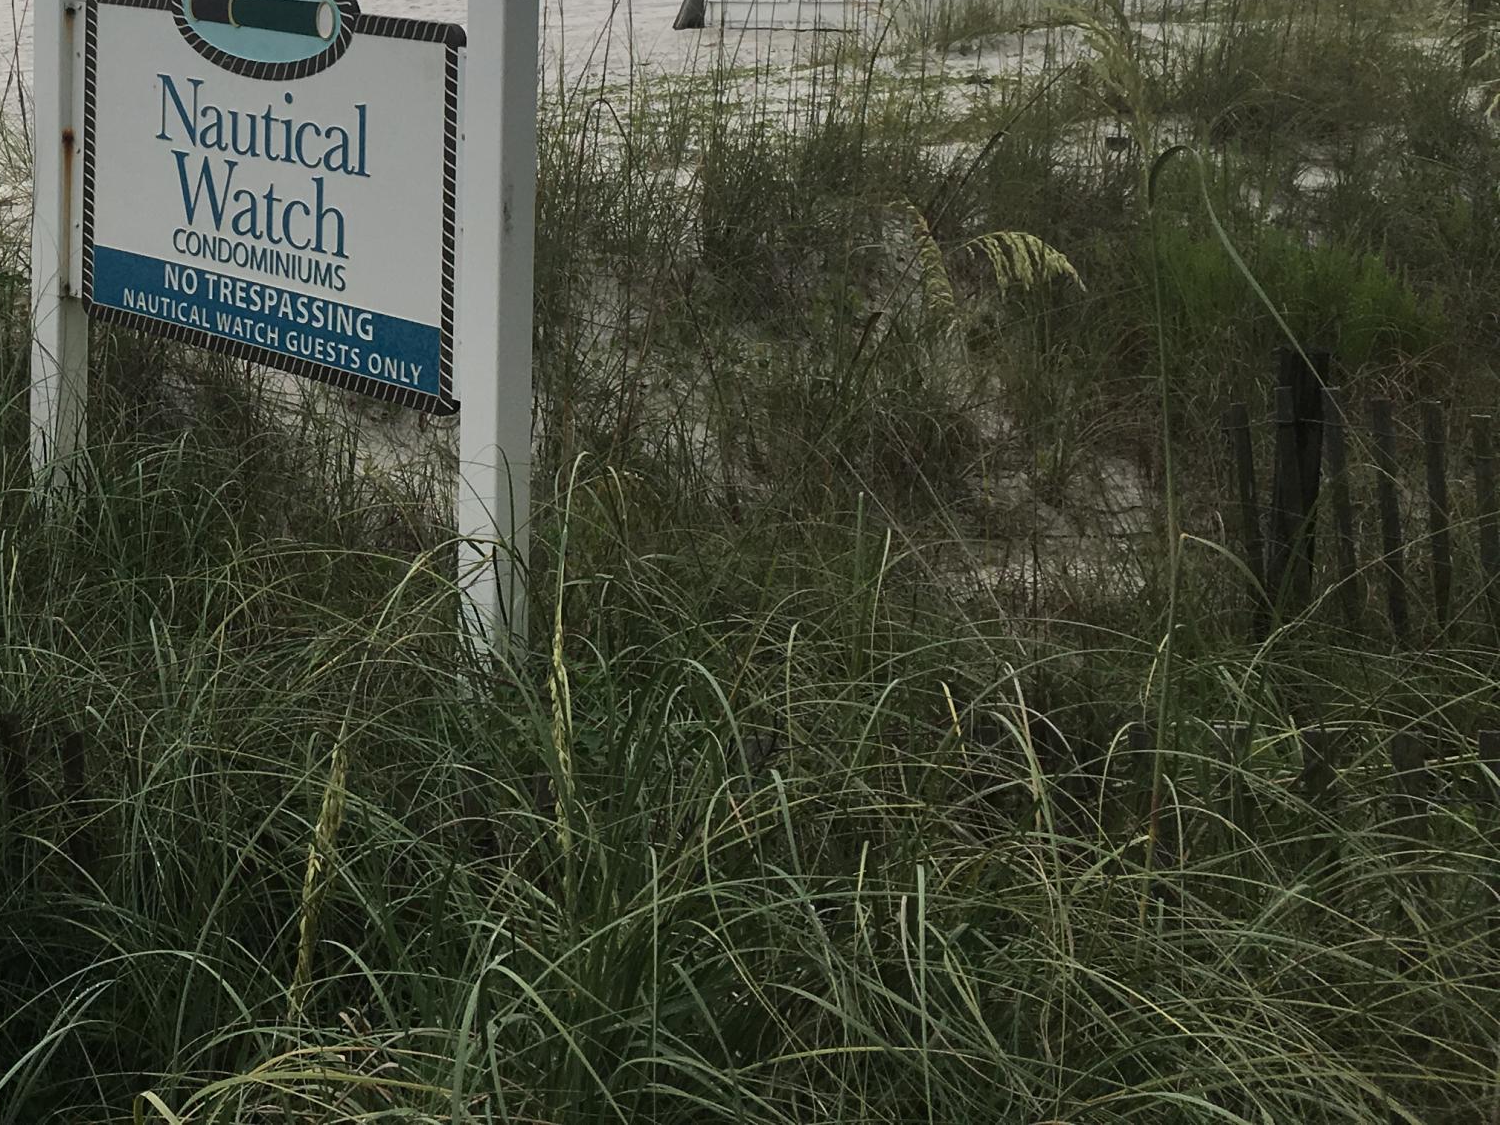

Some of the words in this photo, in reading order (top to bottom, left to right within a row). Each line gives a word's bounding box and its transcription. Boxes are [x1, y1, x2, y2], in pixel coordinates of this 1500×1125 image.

[155, 74, 371, 177] Nautical
[171, 149, 350, 259] Watch
[164, 263, 198, 295] NO
[204, 273, 374, 341] TRESPASSING
[172, 228, 347, 292] CONDOMINIUMS
[123, 288, 210, 328] NAUTICAL
[216, 311, 279, 347] WATCH
[285, 331, 361, 370] GUESTS
[367, 352, 423, 386] ONLY
